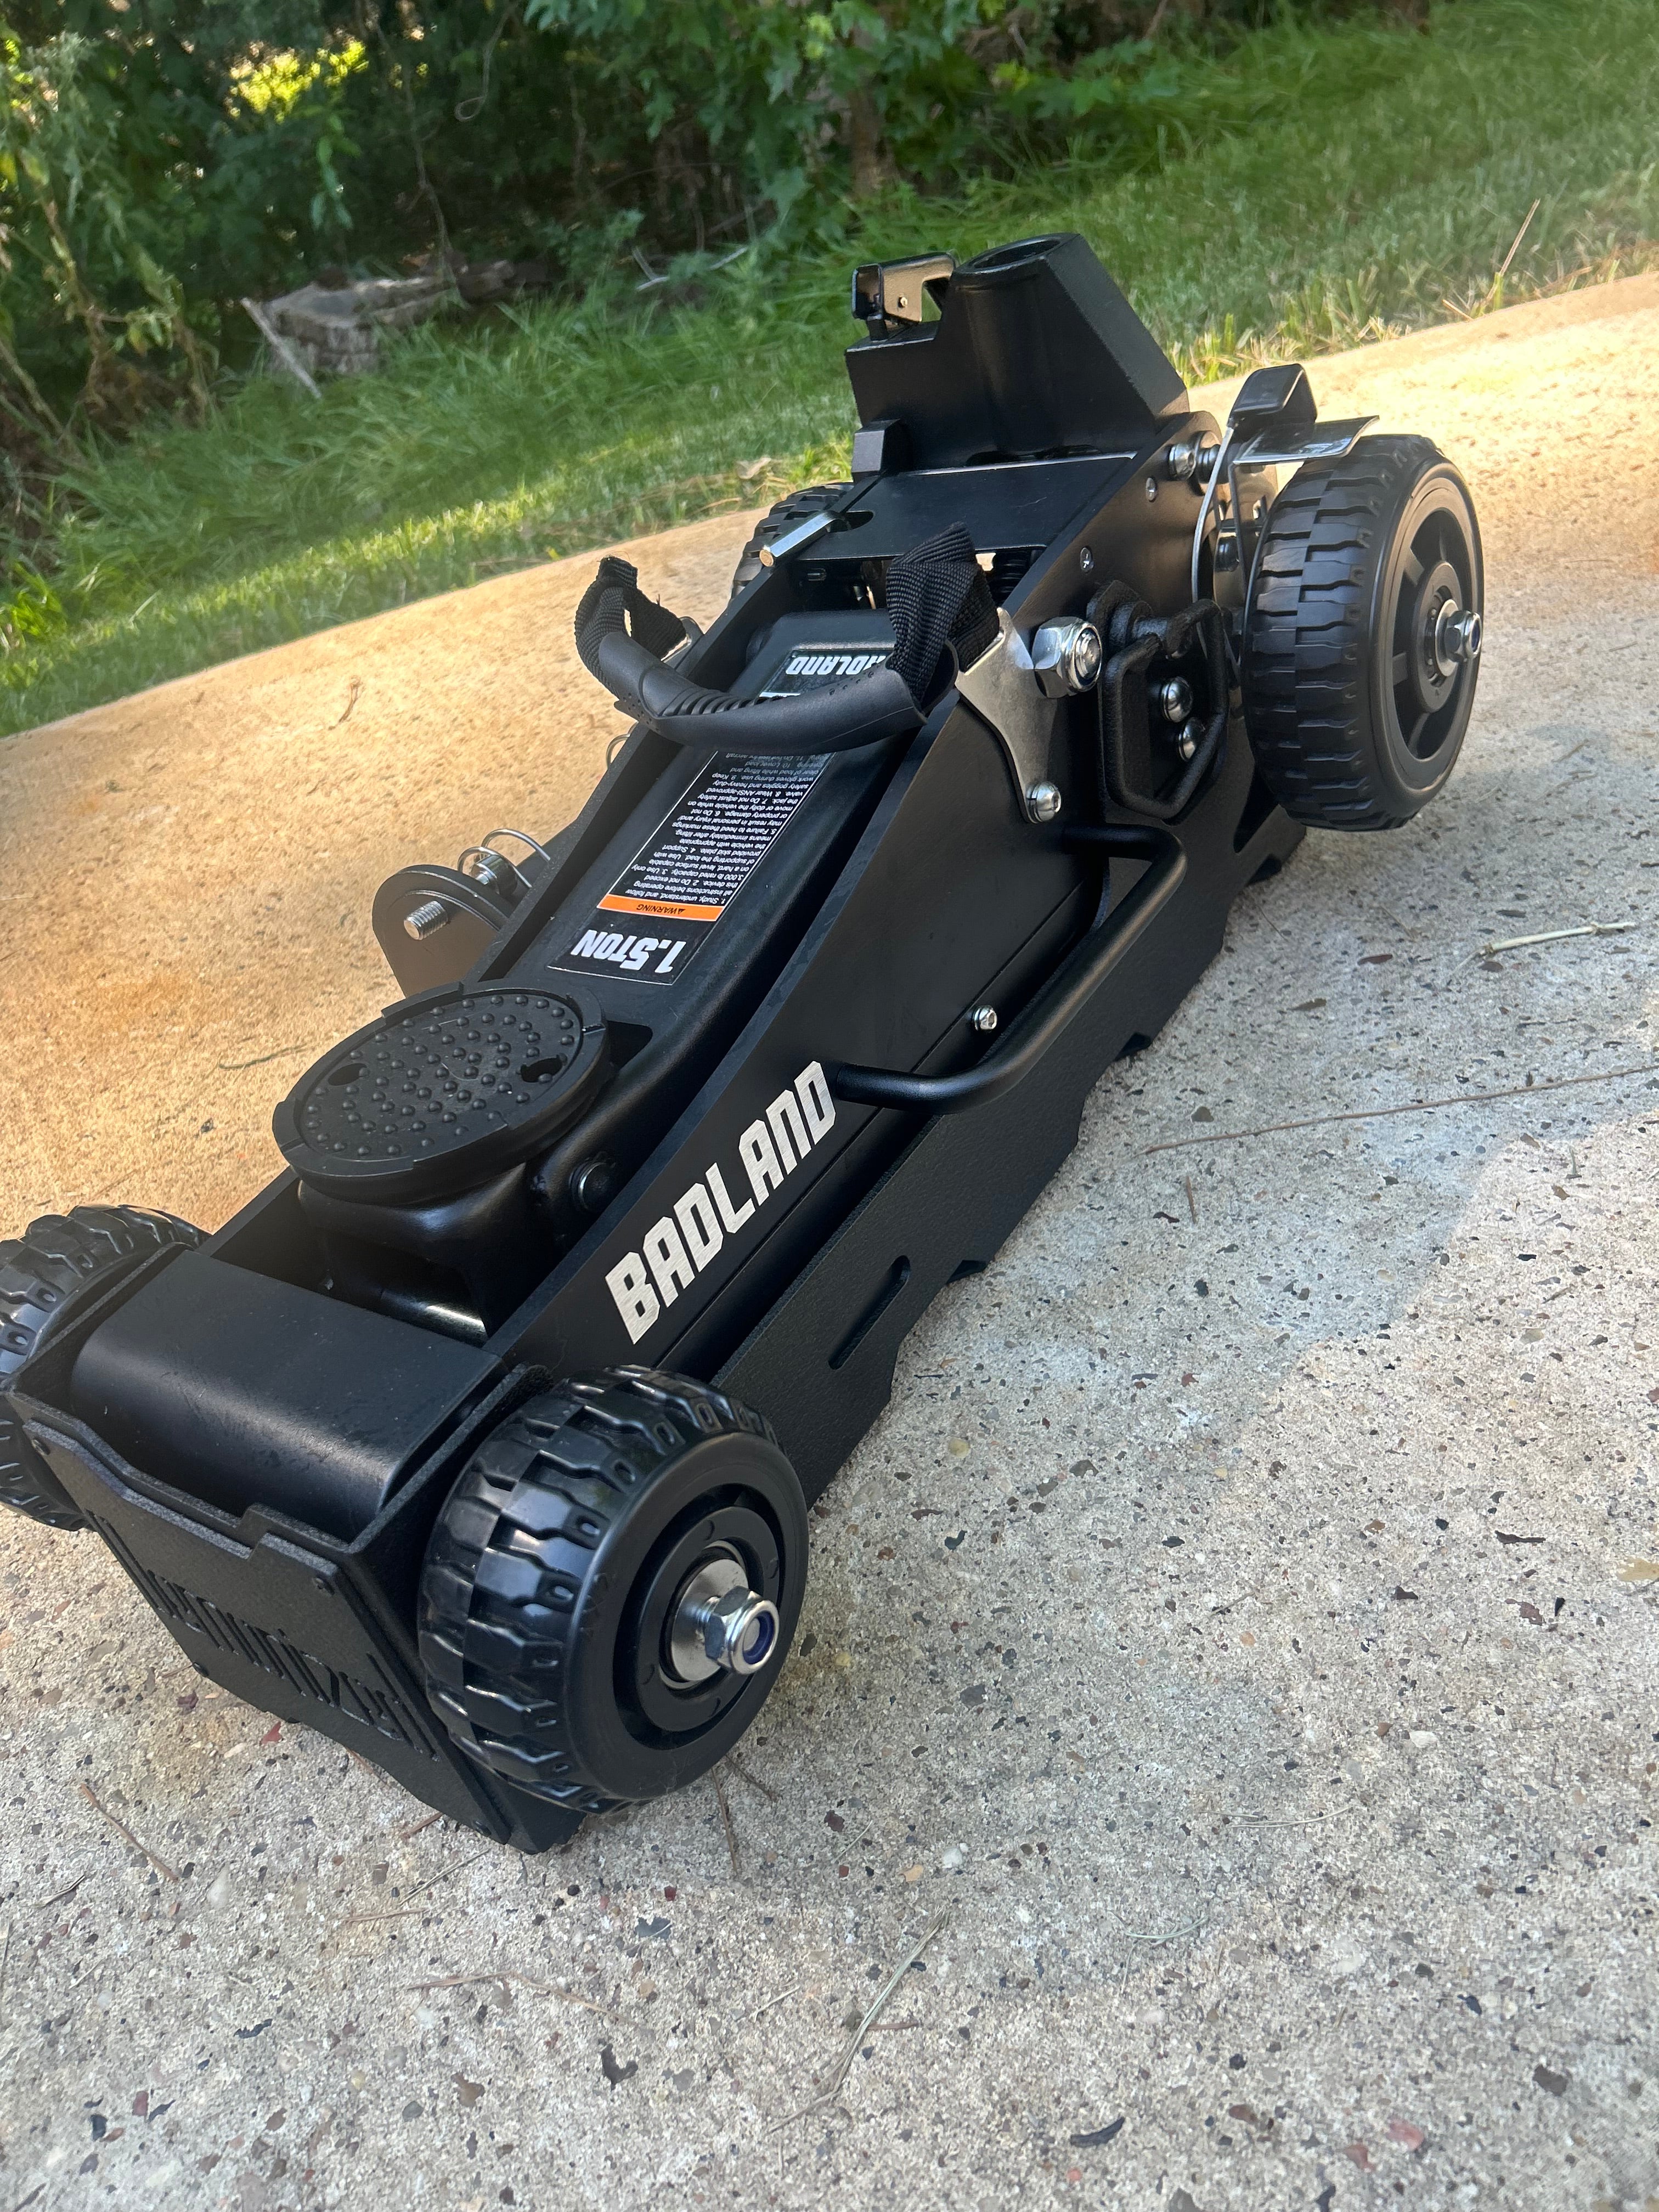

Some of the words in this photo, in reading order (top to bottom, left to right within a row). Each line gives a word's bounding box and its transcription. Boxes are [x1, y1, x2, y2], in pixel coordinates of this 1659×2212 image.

[754, 775, 776, 783] during
[712, 780, 749, 789] heavy-duty
[788, 783, 810, 791] safety
[706, 787, 757, 797] ANSI-approved
[697, 793, 719, 802] safety
[749, 804, 766, 812] dolly
[693, 815, 713, 824] injury
[672, 821, 702, 830] markings
[746, 827, 770, 836] Failure
[709, 832, 749, 842] immediately
[679, 838, 717, 847] appropriate
[662, 844, 689, 854] Support
[648, 859, 675, 867] capable
[712, 856, 748, 865] supporting
[646, 866, 661, 874] Use
[675, 861, 700, 870] surface
[644, 874, 669, 883] exceed
[633, 881, 665, 890] operating
[664, 885, 687, 894] before
[625, 889, 646, 898] follow
[686, 887, 725, 897] instructions
[636, 904, 679, 915] WARNING
[605, 1060, 836, 1345] BADLAND
